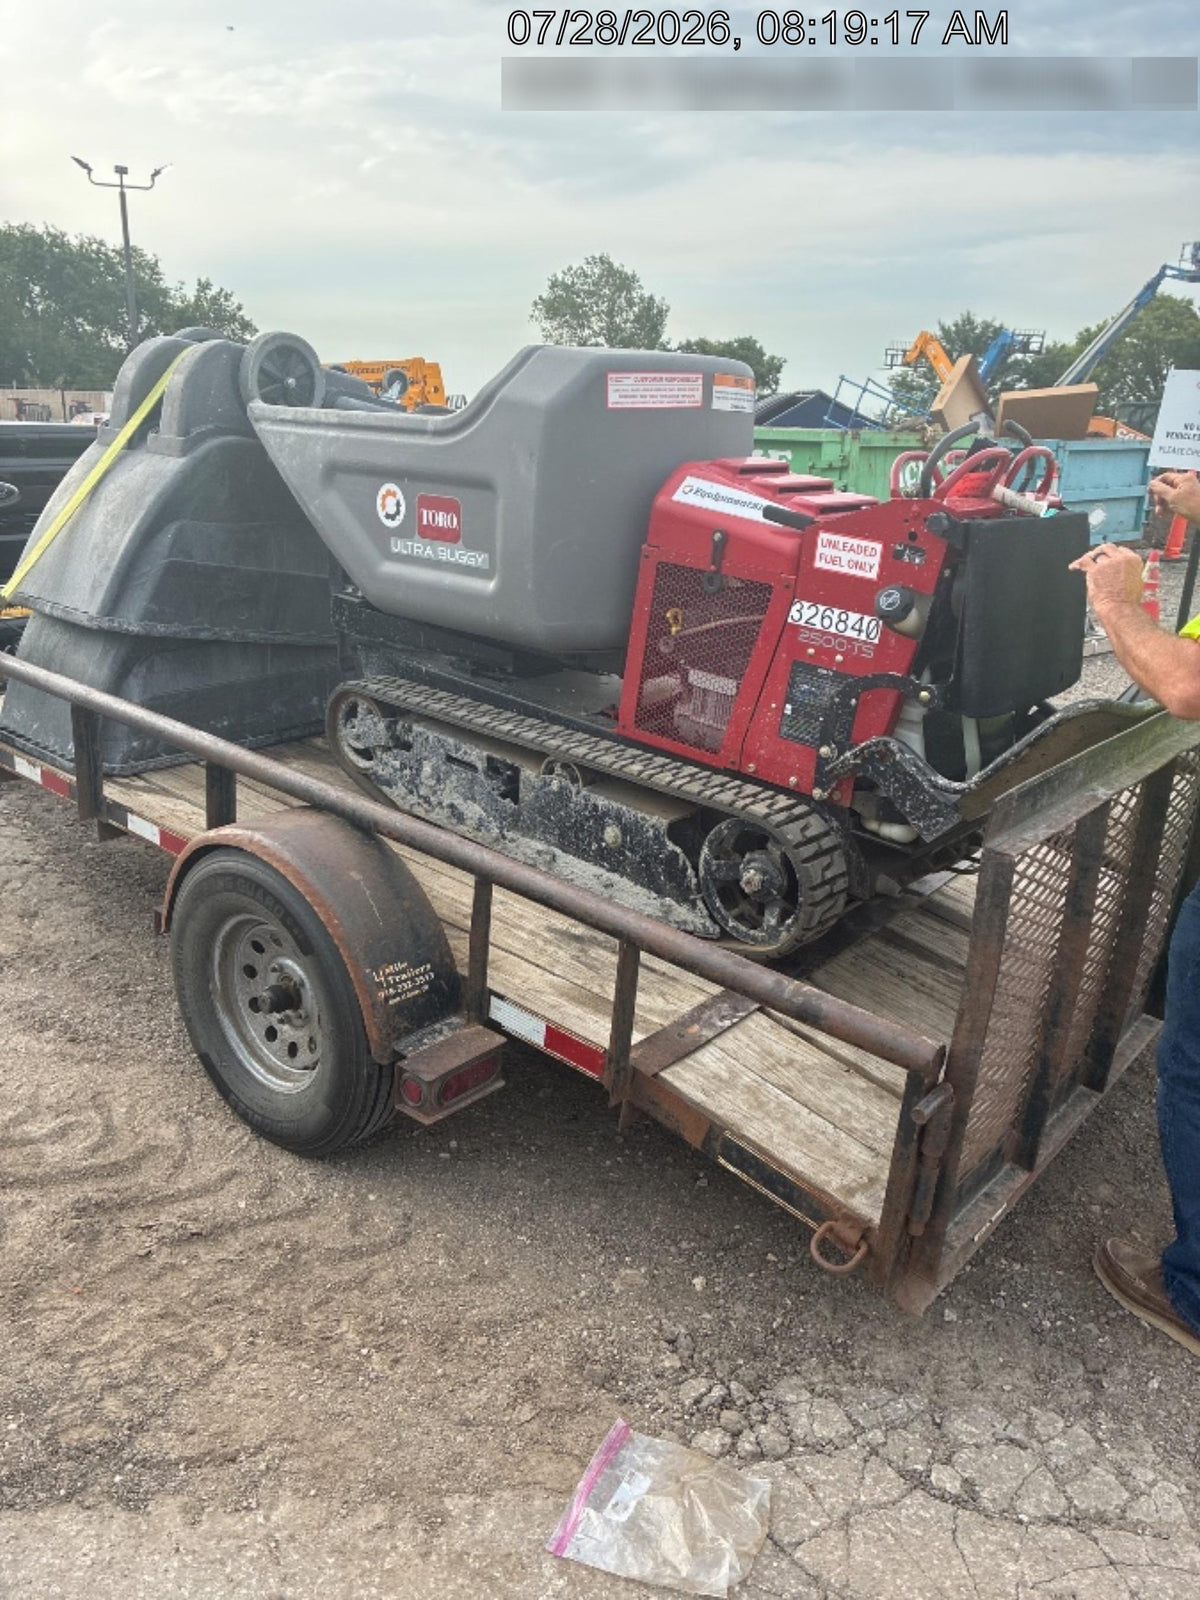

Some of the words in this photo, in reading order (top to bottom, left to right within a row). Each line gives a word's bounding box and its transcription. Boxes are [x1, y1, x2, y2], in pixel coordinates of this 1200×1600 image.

[420, 508, 458, 529] TORO
[390, 537, 434, 558] ULTRA
[438, 547, 485, 566] BUGGY
[820, 538, 877, 558] UNLEADED
[819, 552, 845, 568] FUEL
[848, 558, 876, 574] ONLY
[791, 600, 879, 641] 326840
[798, 629, 875, 659] 2500-TS
